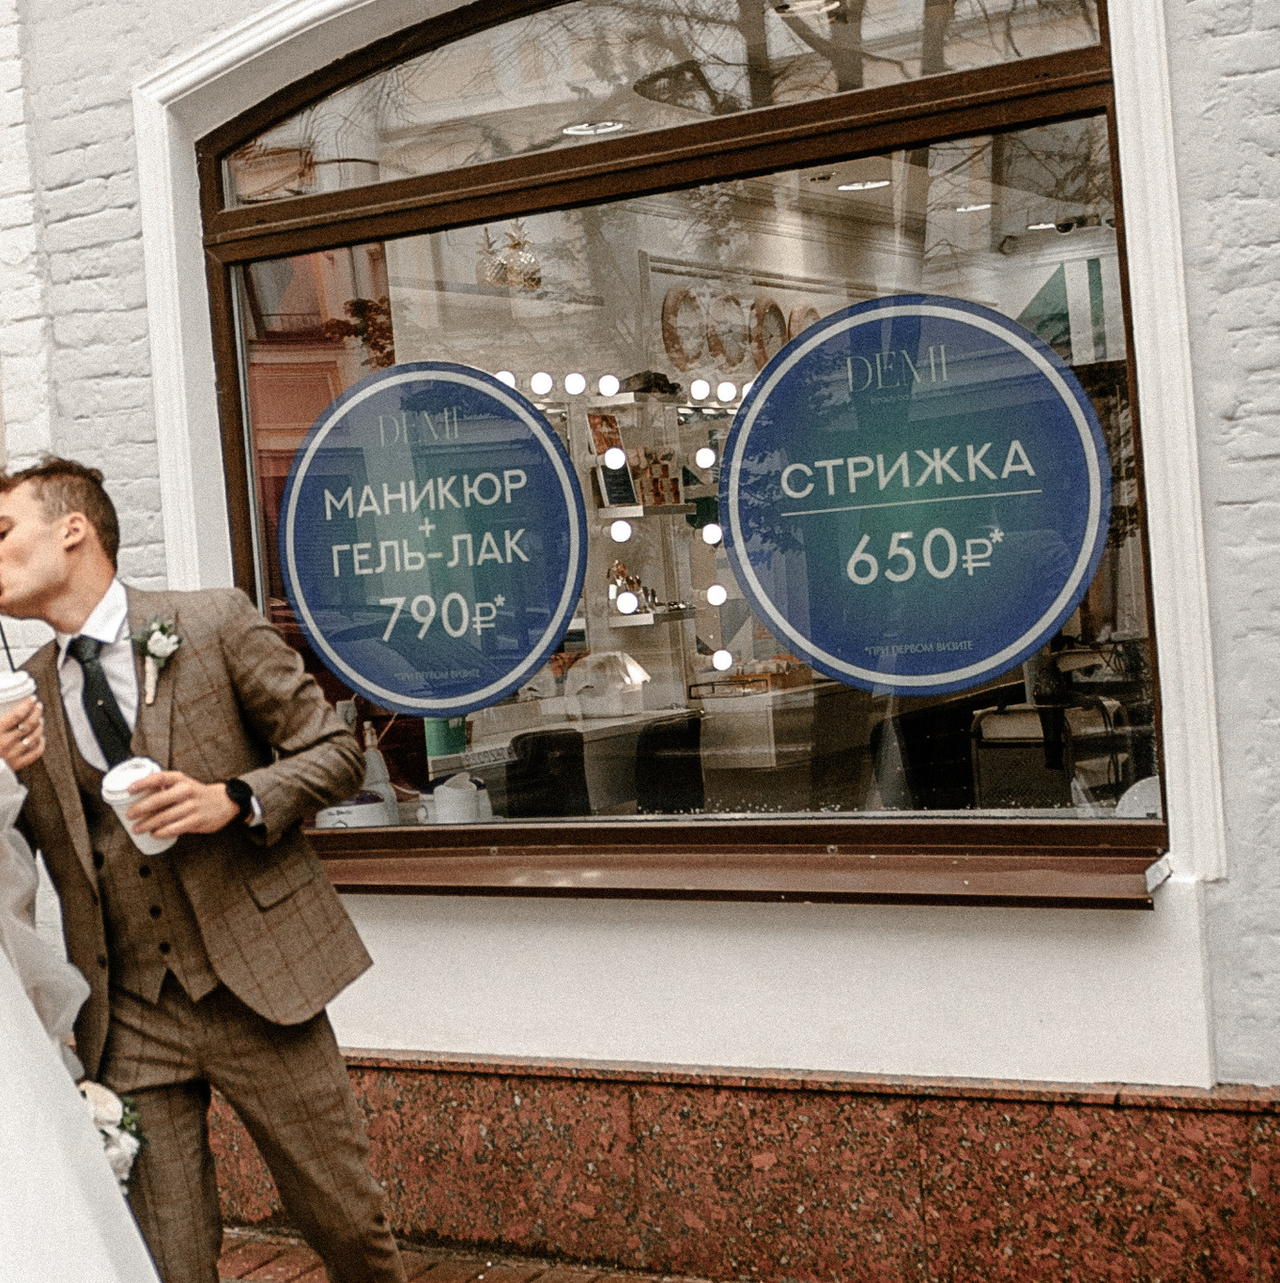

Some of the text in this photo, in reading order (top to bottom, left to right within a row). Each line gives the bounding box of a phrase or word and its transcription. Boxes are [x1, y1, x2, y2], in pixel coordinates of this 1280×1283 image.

[846, 344, 949, 393] DEMI
[781, 439, 1036, 499] СТРИЖКА
[324, 469, 527, 521] МАНИКЮР
[331, 528, 530, 577] ГЕЛЬ-ЛАК
